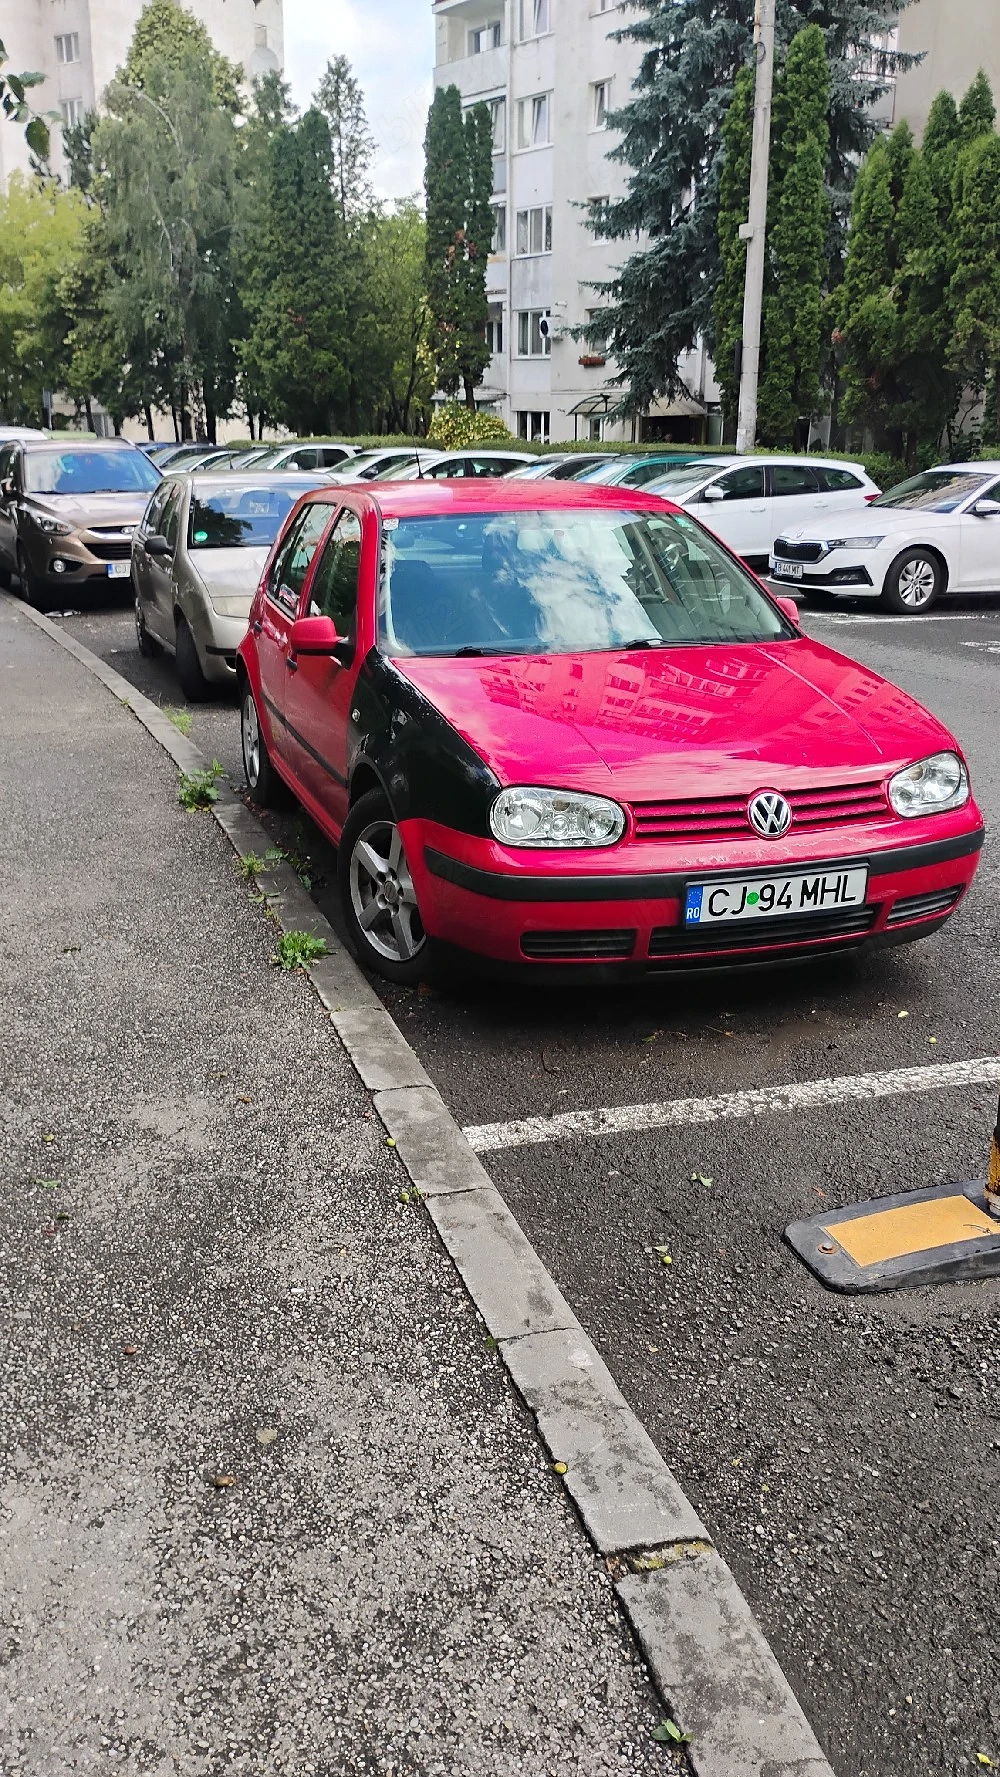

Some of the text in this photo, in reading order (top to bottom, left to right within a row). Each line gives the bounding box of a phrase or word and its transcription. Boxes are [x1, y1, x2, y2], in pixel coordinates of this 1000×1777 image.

[708, 874, 856, 917] CJ 94 MHL
[686, 907, 700, 919] RO
